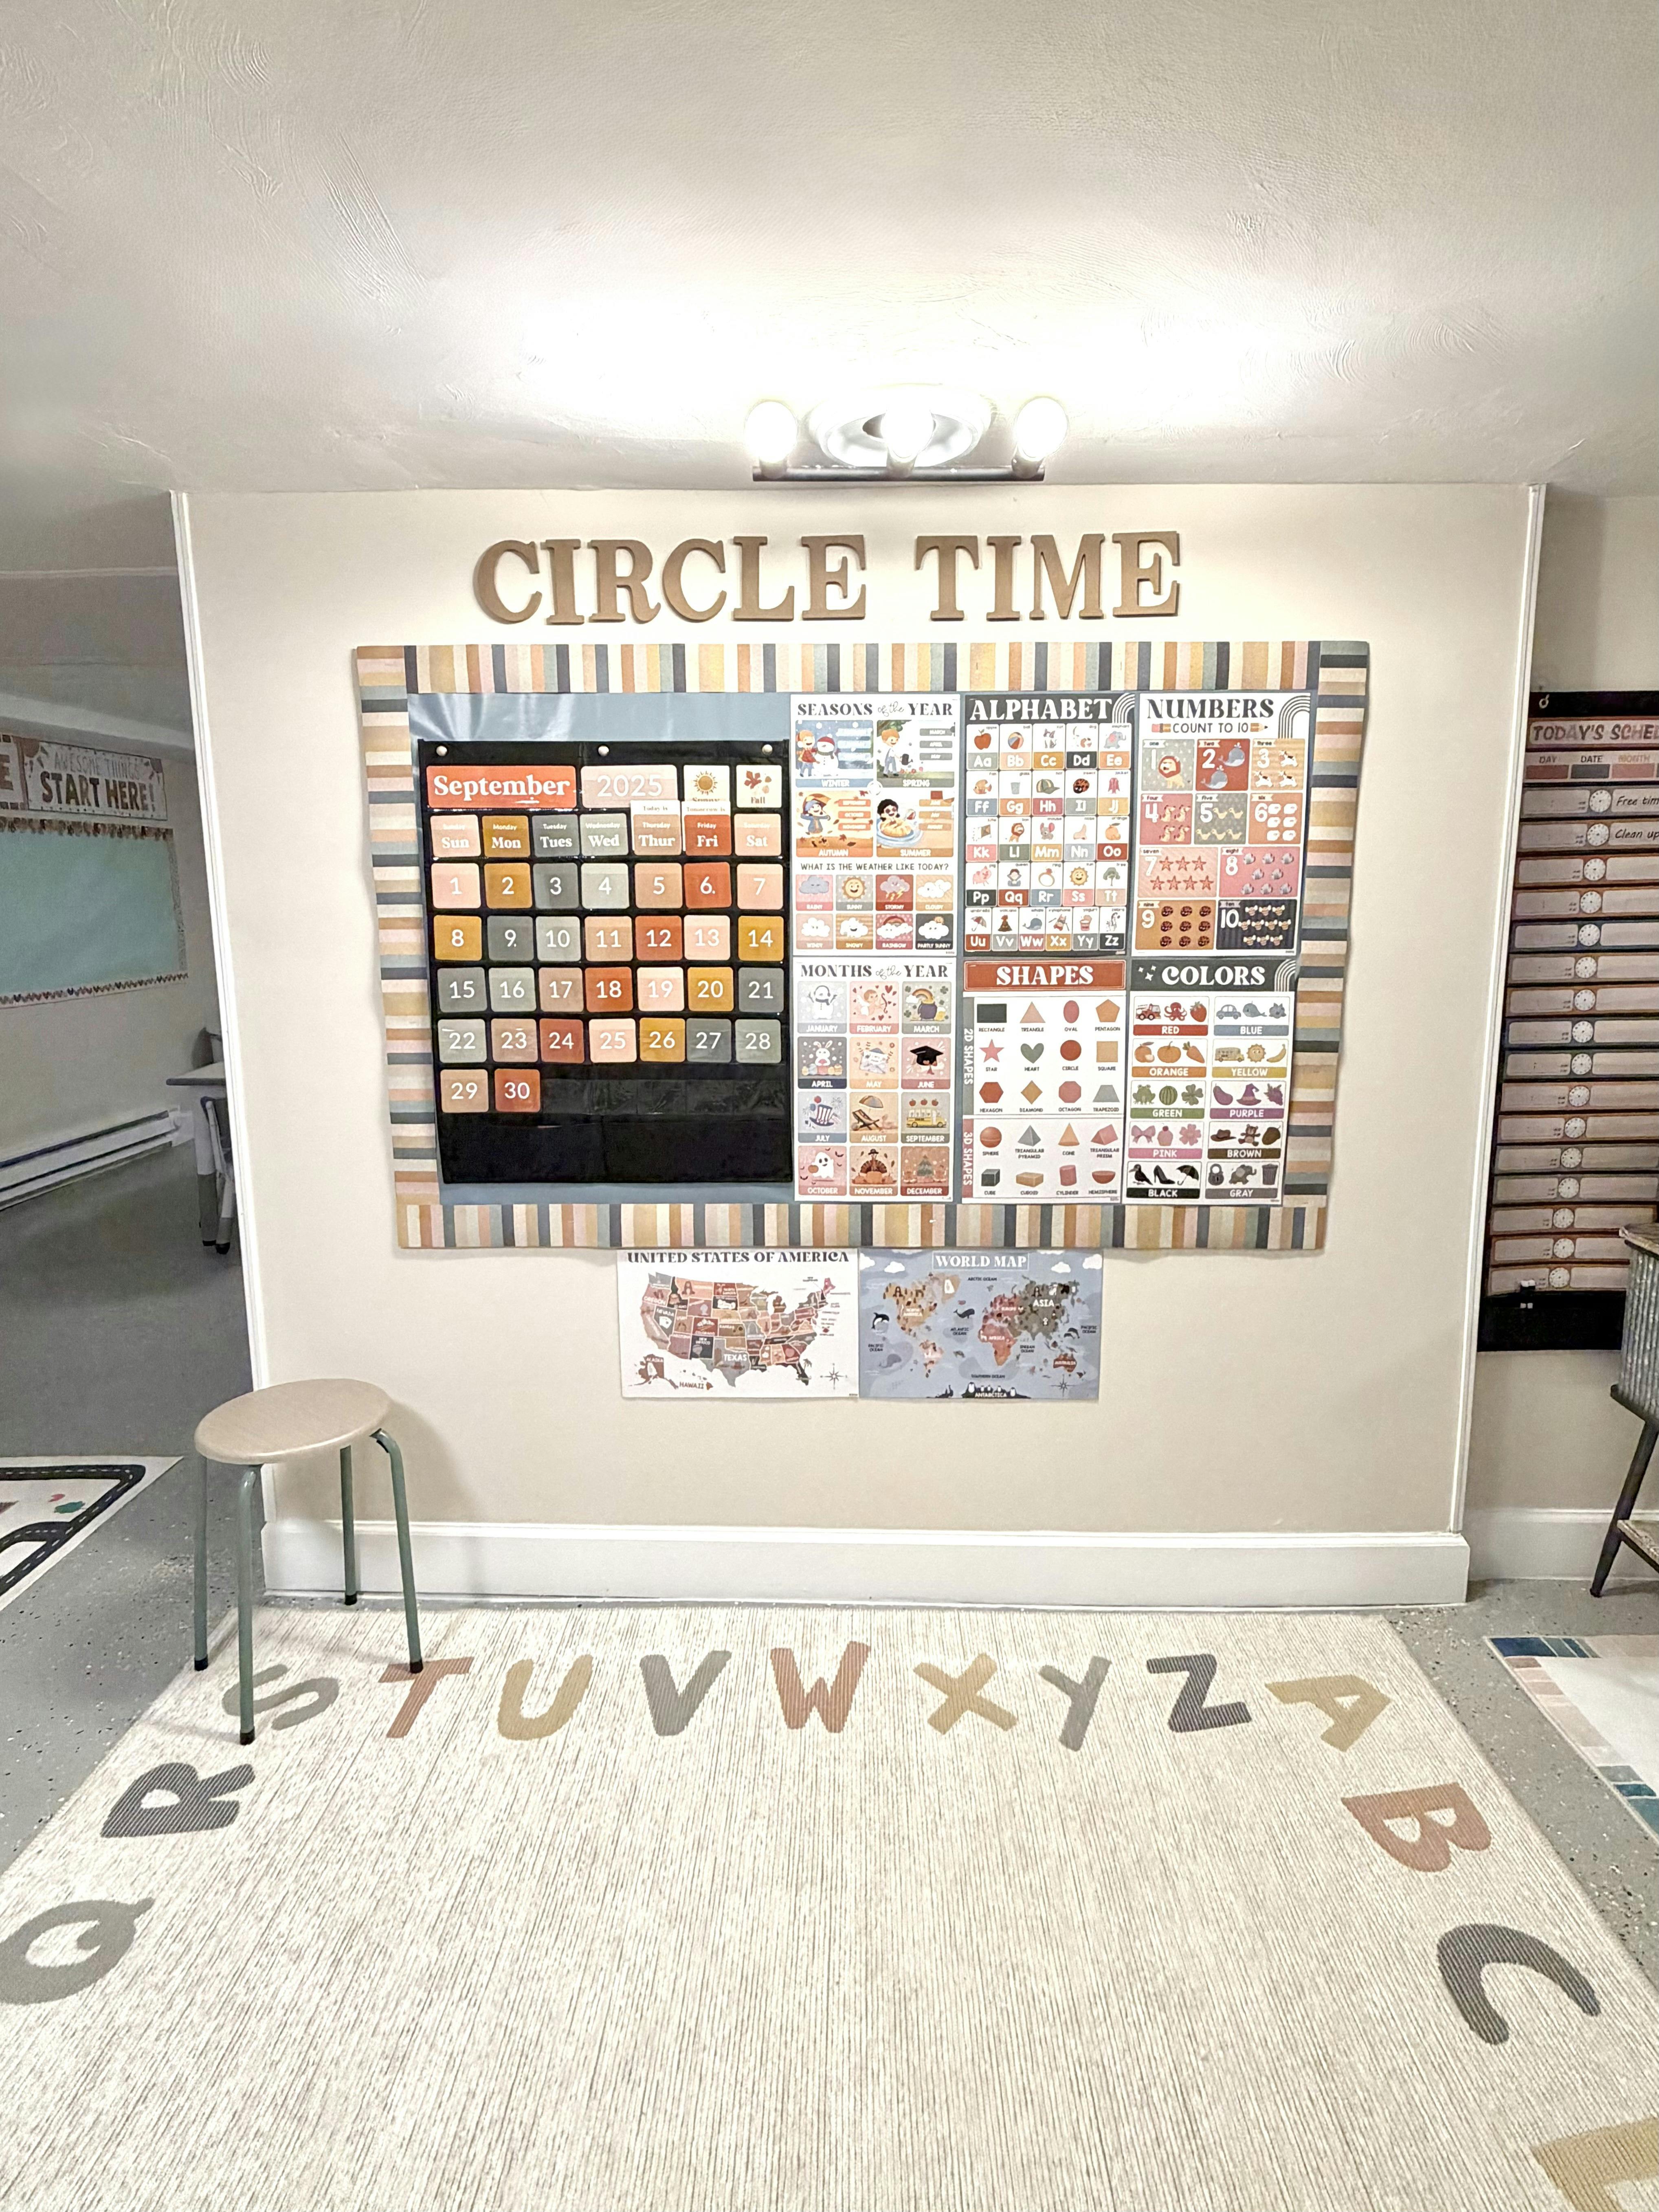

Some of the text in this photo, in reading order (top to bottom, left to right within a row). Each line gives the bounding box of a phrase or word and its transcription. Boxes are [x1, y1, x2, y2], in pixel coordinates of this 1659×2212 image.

[473, 531, 1180, 625] CIRCLE TIME
[798, 701, 953, 717] SEASONS of the YEAR
[969, 699, 1112, 720] ALPHABET
[1147, 699, 1274, 718] NUMBERS
[1173, 723, 1248, 733] COUNT TO 10
[1534, 724, 1659, 741] TODAY'S SCHE
[974, 756, 991, 767] Aa
[1007, 754, 1024, 767] Bb
[1041, 755, 1056, 766] Cc
[1074, 754, 1090, 766] Dd
[1106, 754, 1123, 766] Ee
[1202, 749, 1216, 769] 2
[40, 771, 156, 812] START HERE!
[433, 774, 570, 801] September
[597, 775, 662, 797] 2025
[1617, 796, 1637, 806] Free
[1200, 803, 1213, 822] 5
[1615, 829, 1642, 839] Clean
[442, 835, 768, 848] Sun Mon Tues Wed Thur Fri Sat
[1103, 846, 1121, 857] Oo
[1226, 856, 1238, 876] 8
[450, 877, 462, 895] 1
[502, 876, 514, 894] 2
[550, 877, 561, 895] 3
[598, 877, 611, 895] 4
[653, 877, 665, 894] 5
[754, 878, 766, 895] 7
[973, 891, 989, 905] Pp
[1005, 892, 1023, 905] Qq
[1141, 909, 1155, 928] 9
[1220, 909, 1239, 928] 10
[451, 929, 464, 947] 8
[546, 930, 570, 947] 10
[596, 930, 621, 947] 11
[646, 929, 672, 947] 12
[694, 929, 719, 947] 13
[748, 929, 773, 947] 14
[971, 936, 986, 947] Uu
[1050, 936, 1067, 946] Xx
[1105, 935, 1119, 946] Zz
[801, 964, 872, 977] MONTHS
[904, 965, 948, 977] YEAR
[996, 965, 1094, 985] SHAPES
[1162, 966, 1265, 985] COLORS
[449, 980, 773, 998] 15 16 17 18 19 20 21
[1162, 1026, 1180, 1035] RED
[1240, 1026, 1262, 1035] BLUE
[449, 1031, 771, 1050] 22 23 24 25 26 27 28
[964, 1028, 974, 1085] 2D SHAPES
[1149, 1068, 1189, 1076] ORANGE
[1232, 1068, 1268, 1076] YELLOW
[451, 1082, 530, 1099] 29 30
[1152, 1109, 1182, 1118] GREEN
[1230, 1109, 1264, 1118] PURPLE
[963, 1131, 973, 1186] 3D SHAPES
[1153, 1149, 1177, 1158] PINK
[1227, 1149, 1261, 1158] BROWN
[1148, 1189, 1178, 1197] BLACK
[1230, 1189, 1253, 1197] GRAY
[627, 1252, 849, 1263] UNITED STATES OF AMERICA
[936, 1256, 1026, 1267] WORLD MAP
[222, 1640, 1392, 1752] S T U V W X Y Z A
[99, 1762, 256, 1839] R
[1340, 1781, 1493, 1873] B
[0, 1896, 155, 2006] Q
[1436, 1923, 1602, 2045] C
